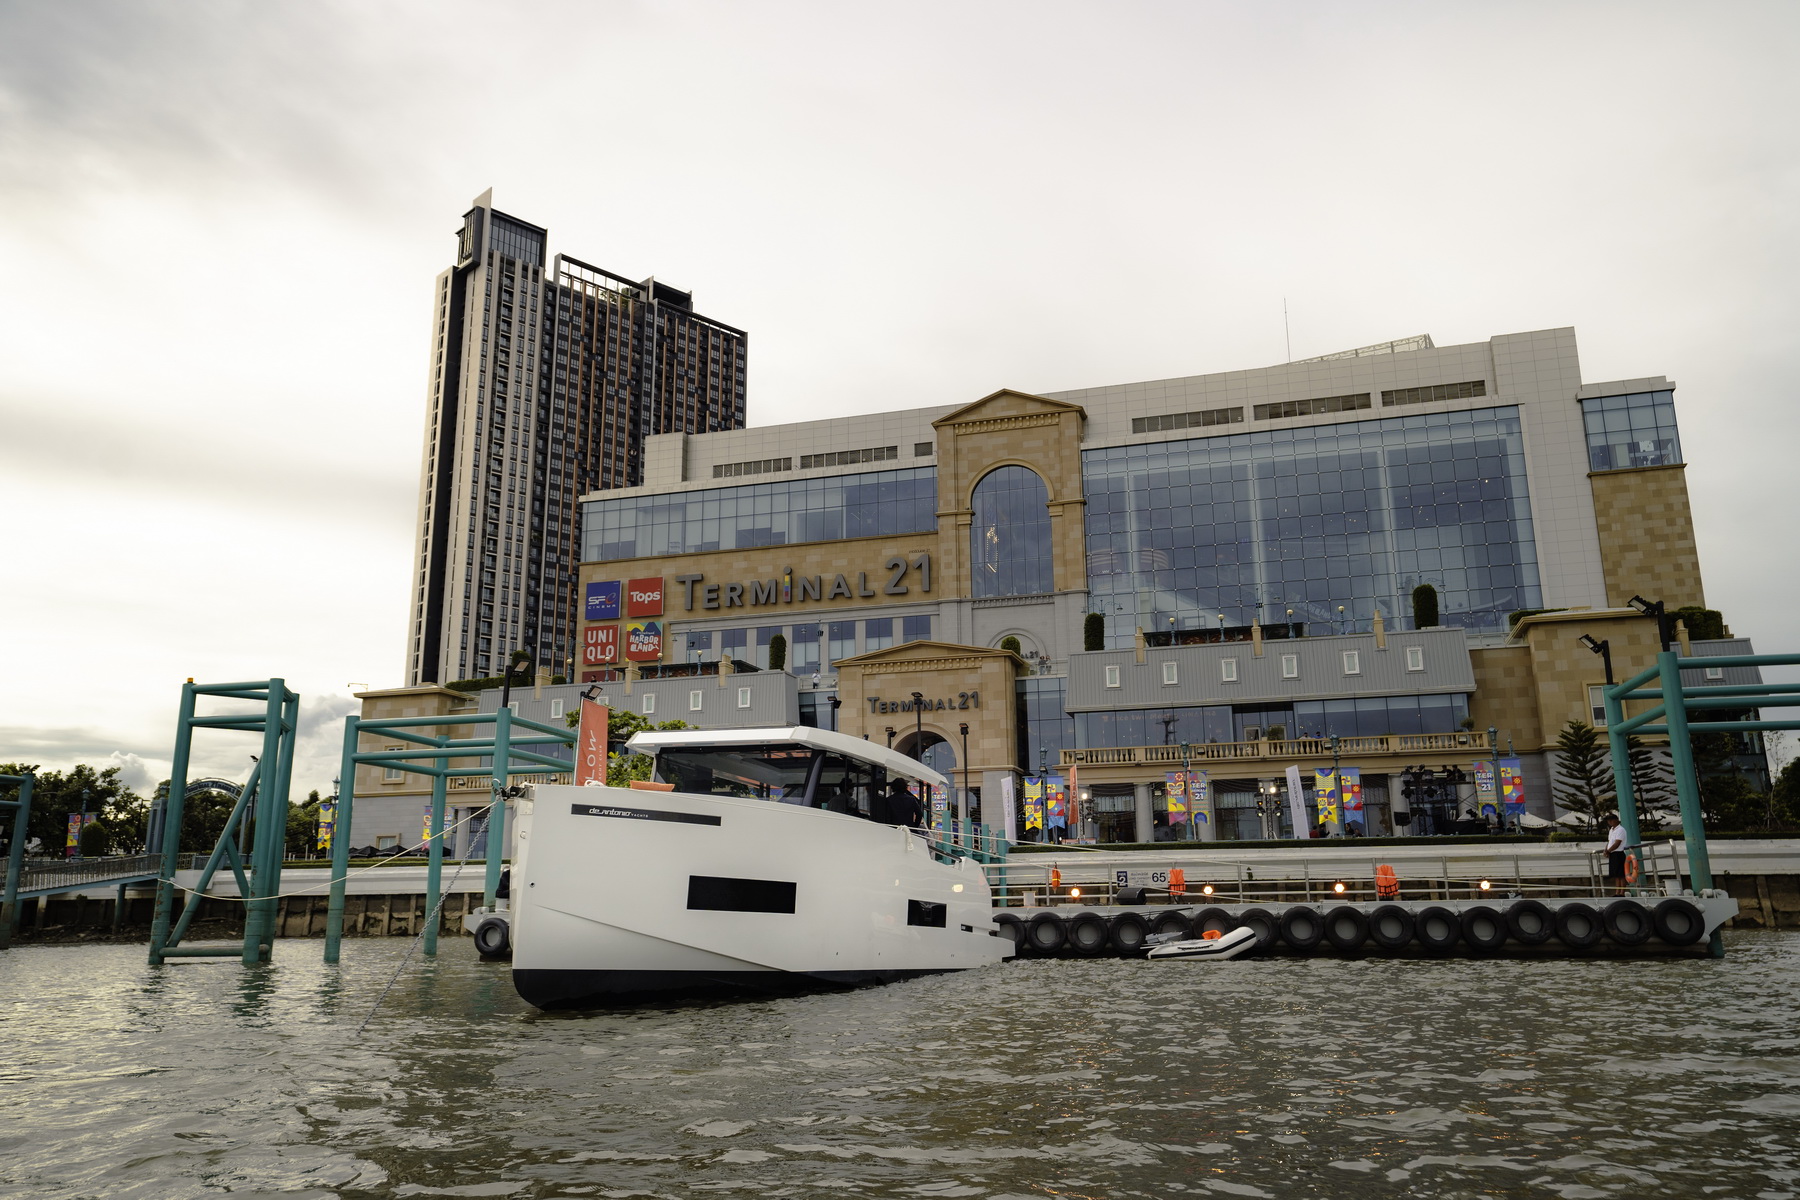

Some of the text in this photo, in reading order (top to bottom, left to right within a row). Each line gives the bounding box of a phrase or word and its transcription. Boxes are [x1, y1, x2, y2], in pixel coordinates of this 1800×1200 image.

[884, 554, 931, 595] 21
[630, 591, 660, 604] Tops
[587, 629, 613, 644] UNI
[629, 634, 659, 645] HARBOR
[586, 645, 615, 662] QLO
[630, 643, 658, 652] LAND
[867, 691, 979, 713] TERMNAL 21
[1119, 876, 1126, 886] 2
[1152, 872, 1166, 882] 65
